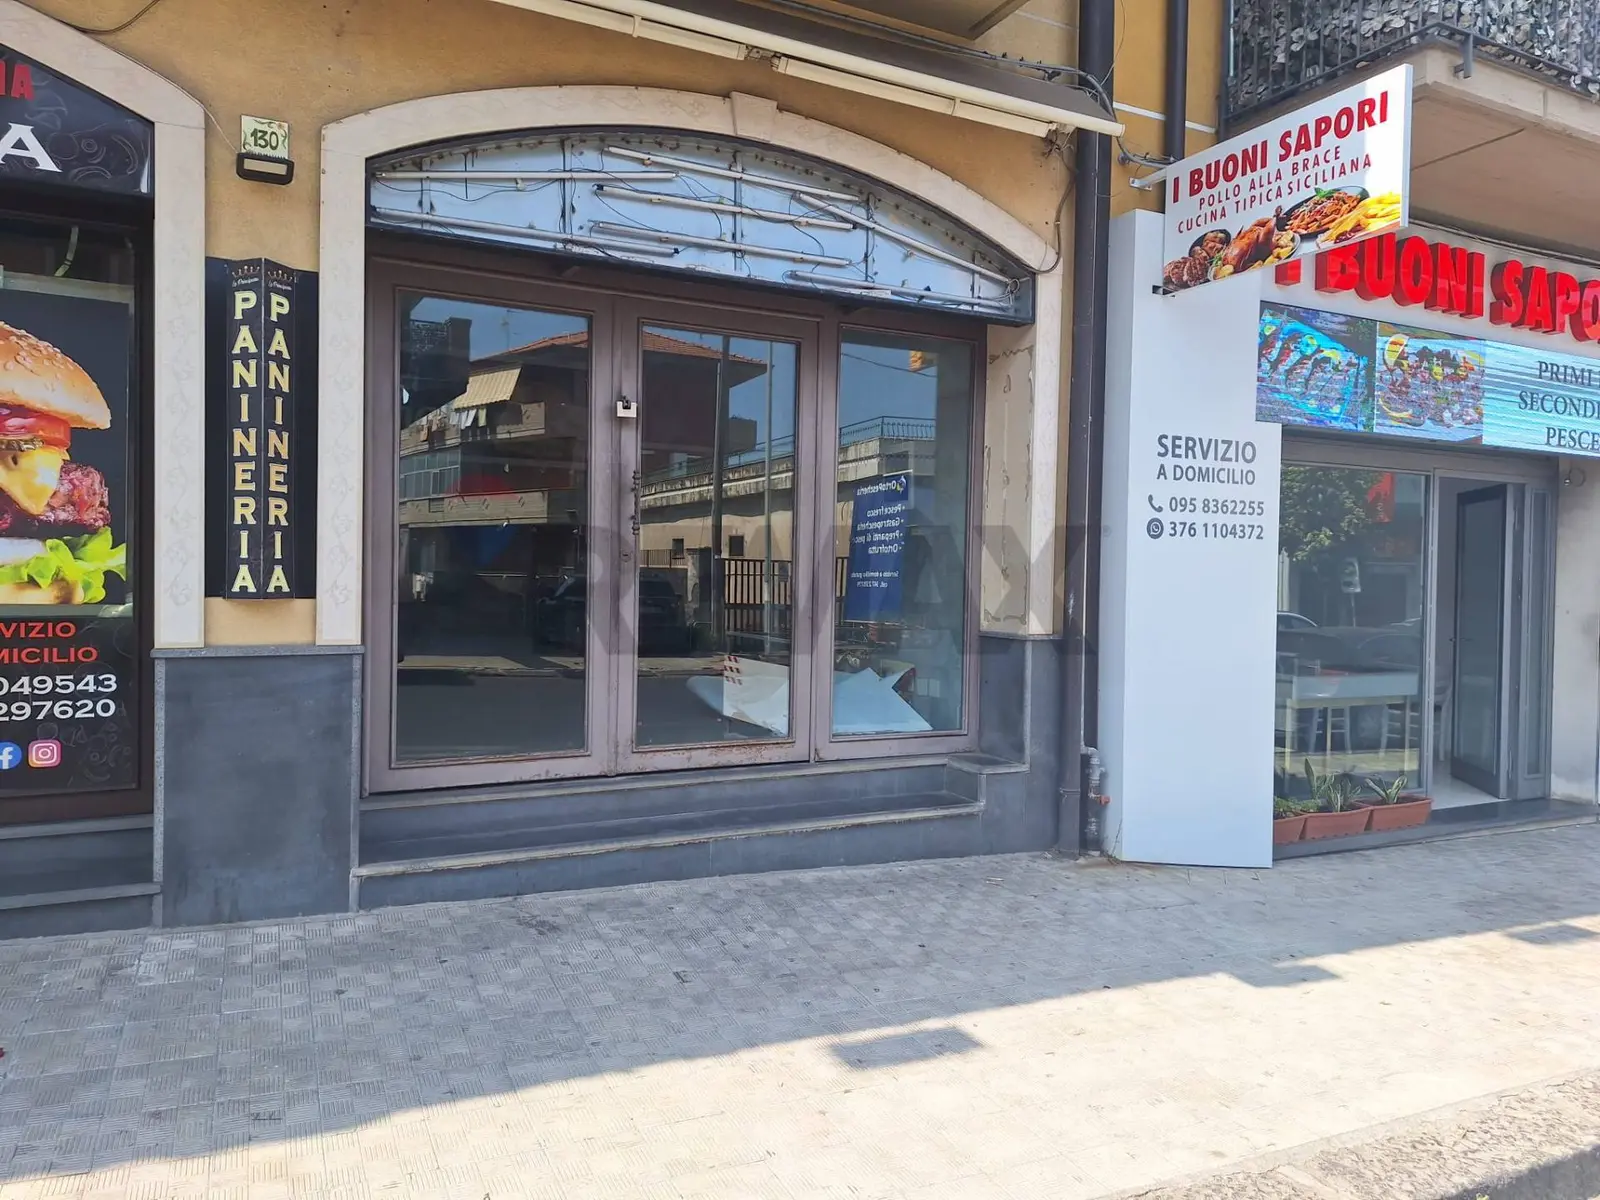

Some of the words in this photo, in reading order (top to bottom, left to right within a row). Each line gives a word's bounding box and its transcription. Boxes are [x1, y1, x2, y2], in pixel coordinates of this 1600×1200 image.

[0, 58, 34, 100] A
[0, 122, 63, 173] A
[249, 127, 279, 151] 130
[1172, 176, 1180, 204] I
[1189, 140, 1268, 197] BUONI
[1279, 91, 1388, 162] SAPORI
[1177, 209, 1227, 234] CUCINA
[1235, 189, 1283, 213] TIPICA
[1287, 153, 1372, 196] SICILIANA
[1199, 183, 1240, 210] POLLO
[1249, 168, 1283, 192] ALLA
[1292, 145, 1341, 176] BRACE
[1315, 232, 1484, 319] BUONI
[1538, 360, 1593, 387] PRIMI
[231, 291, 258, 592] PANINERIA
[267, 292, 290, 593] PANINERIA
[1157, 434, 1257, 464] SERVIZIO
[1156, 463, 1168, 480] A
[1172, 464, 1256, 485] DOMICILIO
[1169, 496, 1197, 513] 095
[1202, 498, 1264, 516] 8362255
[1169, 521, 1197, 538] 376
[1202, 522, 1264, 540] 1104372
